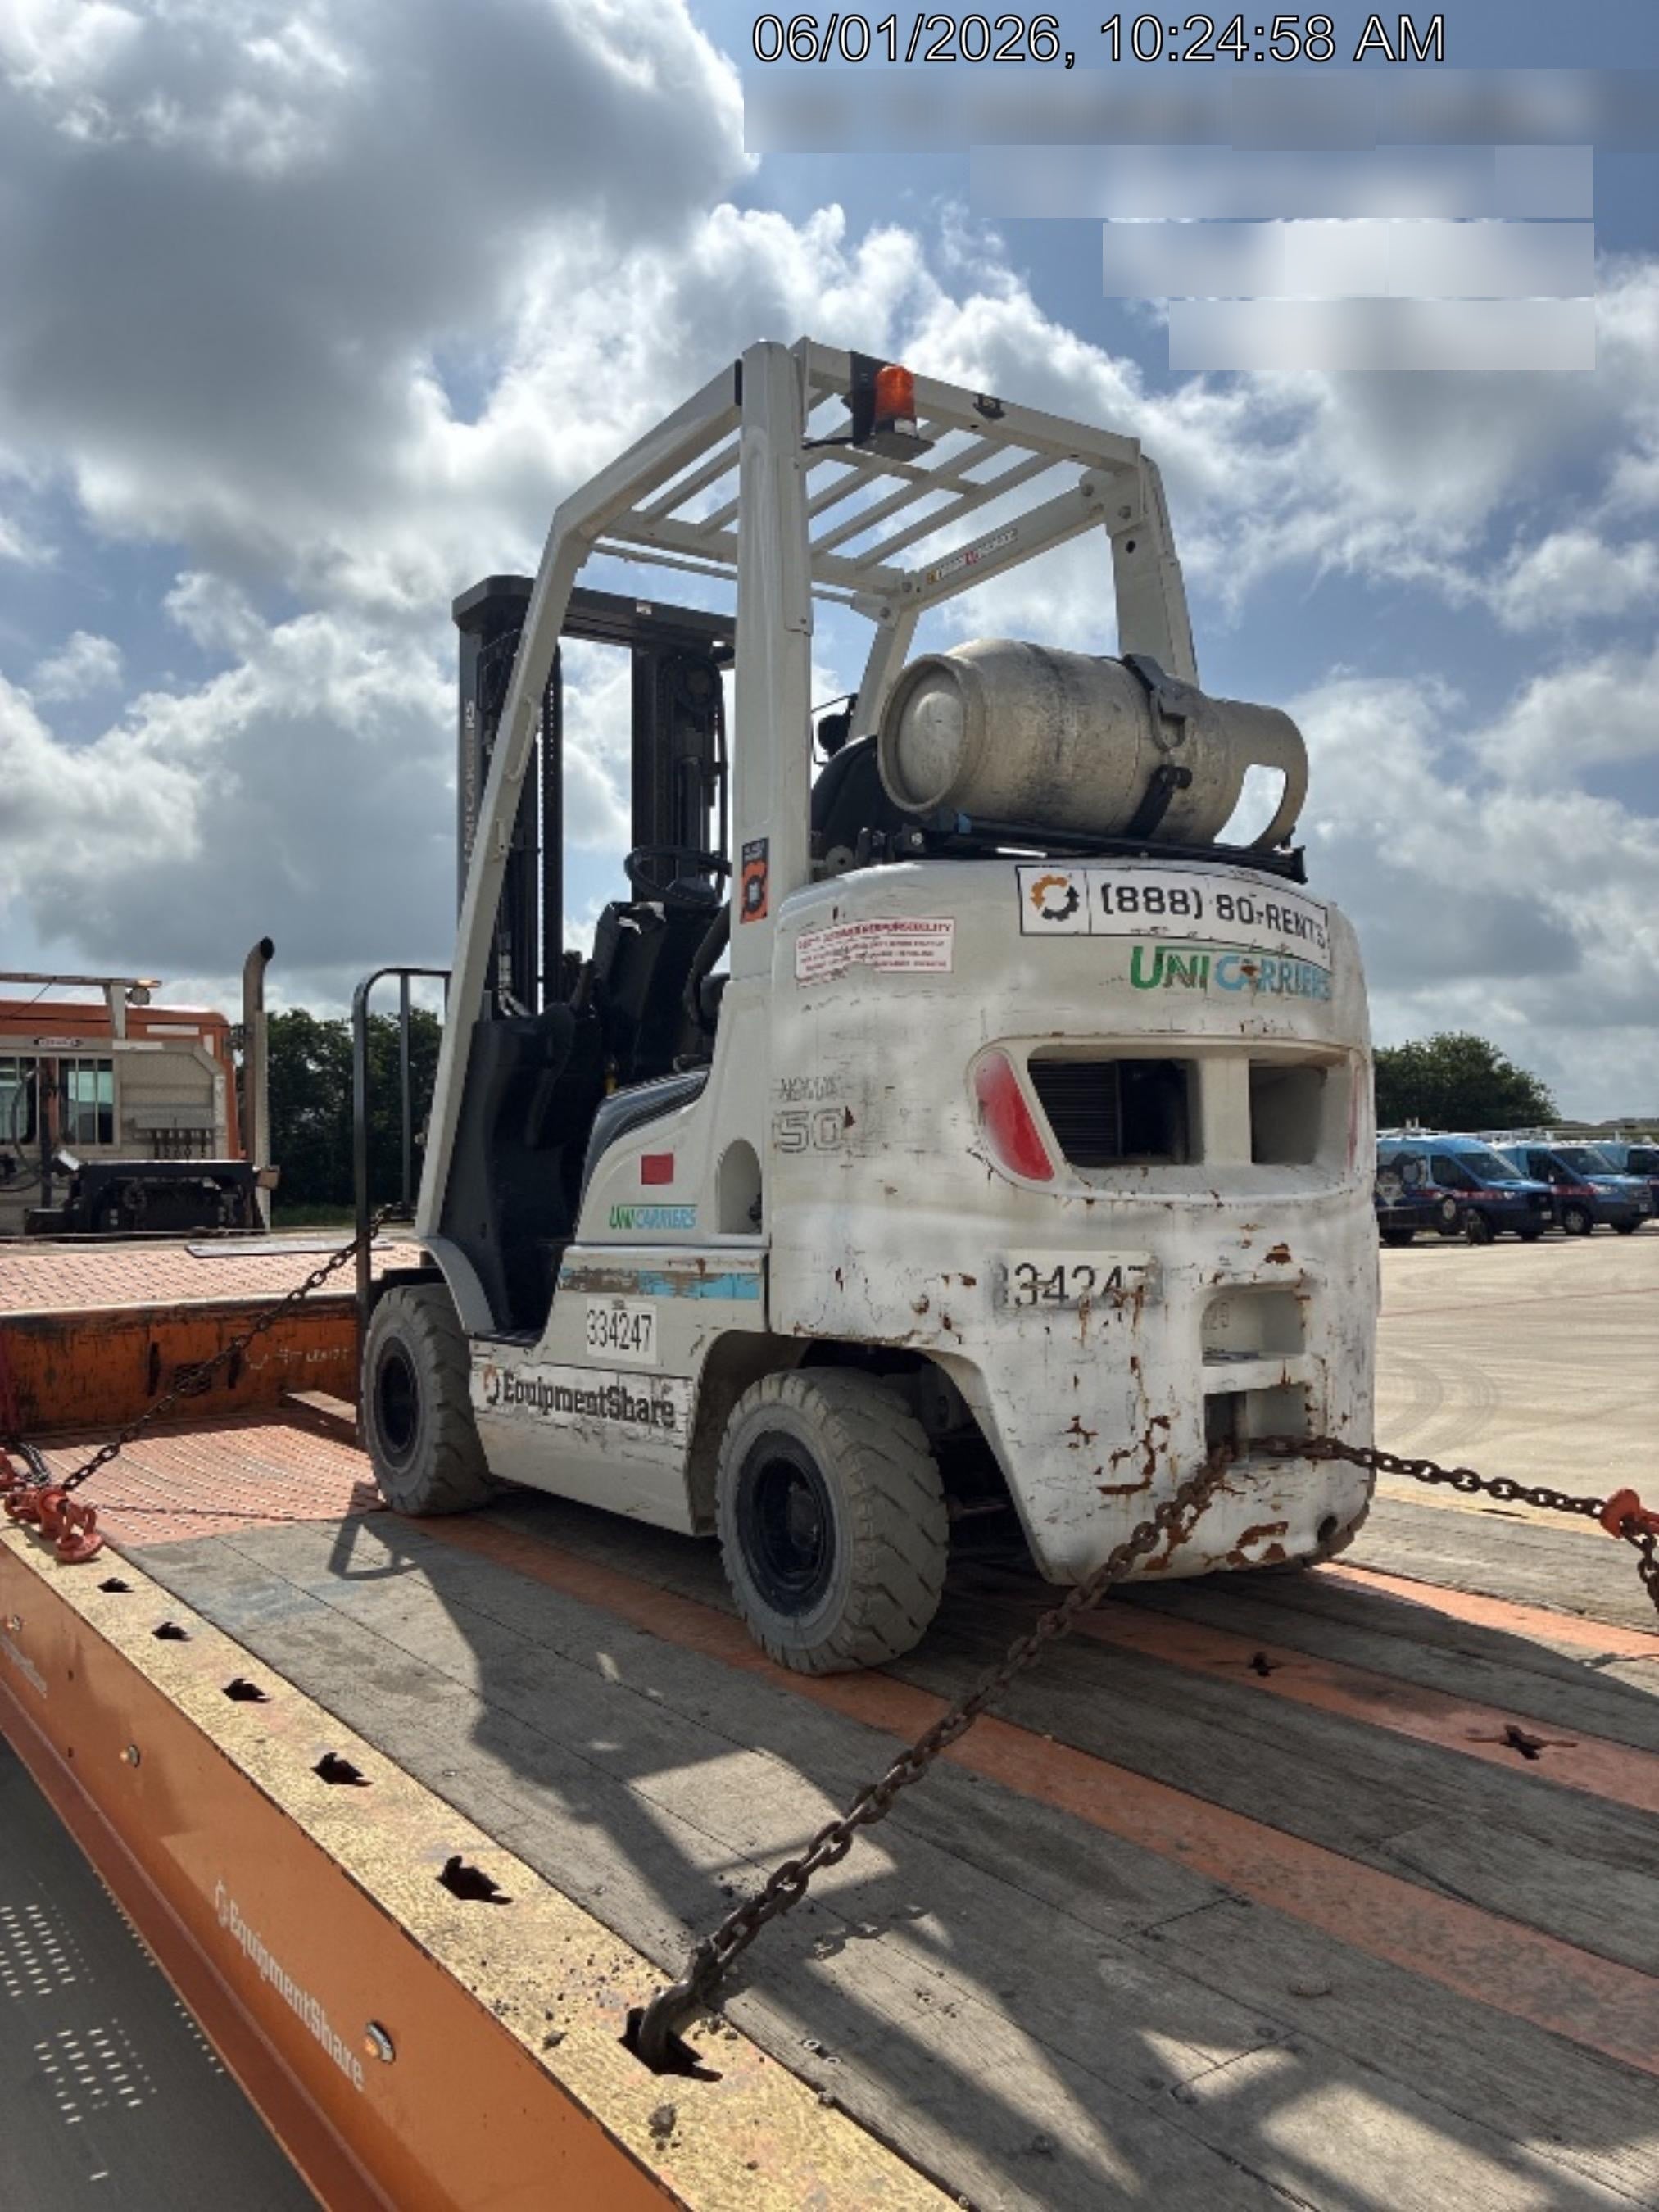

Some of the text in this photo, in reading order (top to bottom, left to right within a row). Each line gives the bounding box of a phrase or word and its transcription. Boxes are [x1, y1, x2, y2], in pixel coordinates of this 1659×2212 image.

[1100, 882, 1327, 950] (888) 80-RENTS
[587, 1309, 652, 1352] 334247
[503, 1370, 675, 1429] EquipmentShare
[229, 1899, 365, 2094] EquipmentShare
